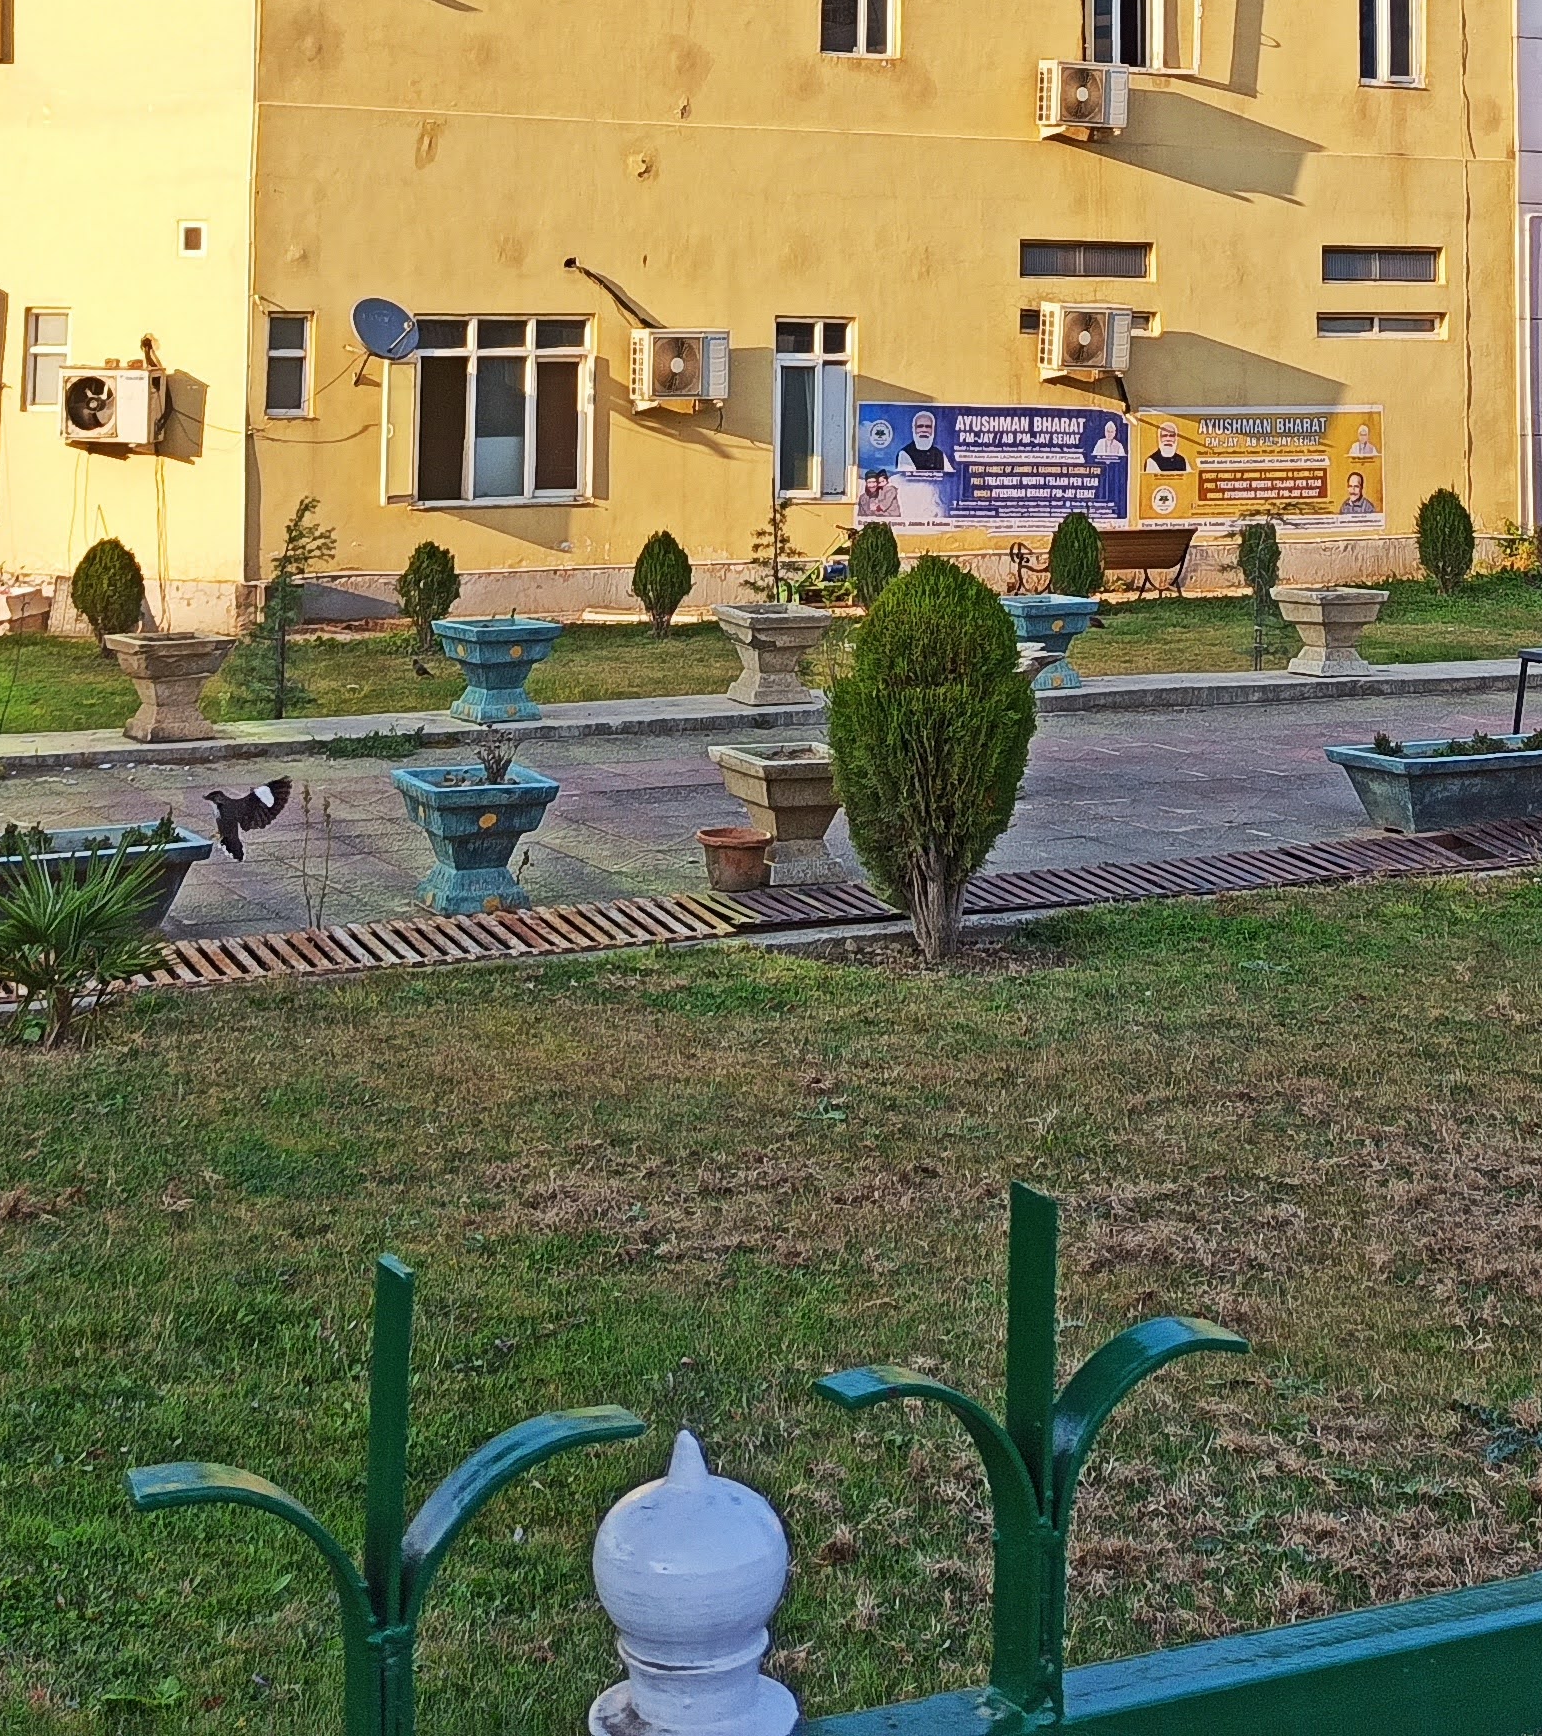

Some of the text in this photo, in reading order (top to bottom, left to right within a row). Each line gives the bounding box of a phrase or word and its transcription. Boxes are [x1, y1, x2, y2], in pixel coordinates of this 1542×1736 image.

[955, 415, 1086, 433] AYUSHMAN BHARAT
[1198, 417, 1327, 435] AYUSHMAN BHARAT
[959, 432, 994, 443] PM-JAY
[1002, 433, 1014, 444] AB
[1016, 433, 1051, 444] PM-JAY
[1052, 434, 1081, 445] SEHAT
[1205, 437, 1238, 448] PM-JAY
[1246, 436, 1257, 447] AB
[1260, 436, 1292, 447] PM-JAY
[1293, 435, 1320, 446] SEHAT
[985, 477, 1021, 486] TREATMENT
[1070, 477, 1082, 486] PER
[992, 488, 1026, 498] AYUSHMAN
[1052, 489, 1075, 498] PM-JAY
[1076, 489, 1096, 499] SEHAT
